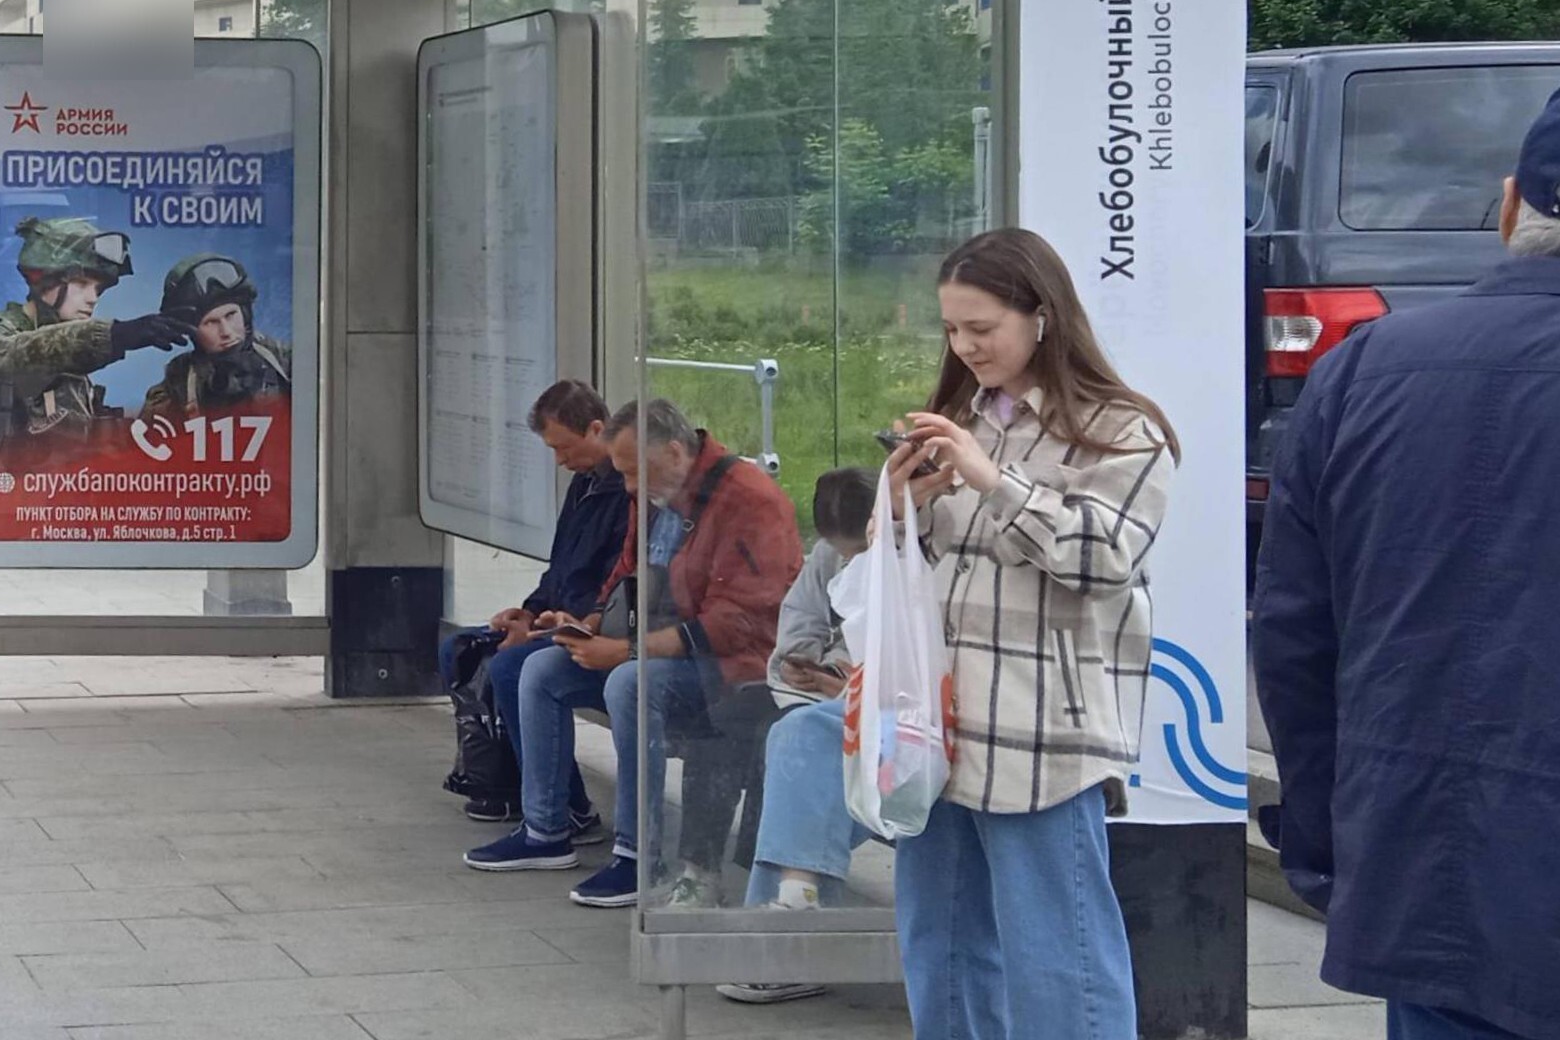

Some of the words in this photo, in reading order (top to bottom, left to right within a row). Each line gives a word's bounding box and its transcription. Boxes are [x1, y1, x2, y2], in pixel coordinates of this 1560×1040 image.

[56, 109, 114, 121] АРМИЯ
[56, 123, 128, 135] РОССИИ
[6, 150, 263, 189] ПРИСОЕДИНЯЙСЯ
[134, 196, 151, 224] К
[162, 197, 263, 224] СВОИМ
[184, 416, 272, 462] 117
[23, 467, 271, 498] службапоконтракту.рф
[16, 507, 53, 522] ПУНКТ
[55, 507, 99, 522] ОТБОРА
[100, 507, 116, 521] НА
[117, 507, 163, 522] СЛУЖБУ
[165, 508, 181, 521] ПО
[184, 508, 251, 522] КОНТРАКТУ:
[31, 529, 39, 539] г.
[43, 526, 90, 540] Москва,
[93, 528, 111, 541] ул.
[113, 526, 181, 541] Яблочкова,
[203, 528, 227, 541] стр.
[230, 526, 236, 539] 1
